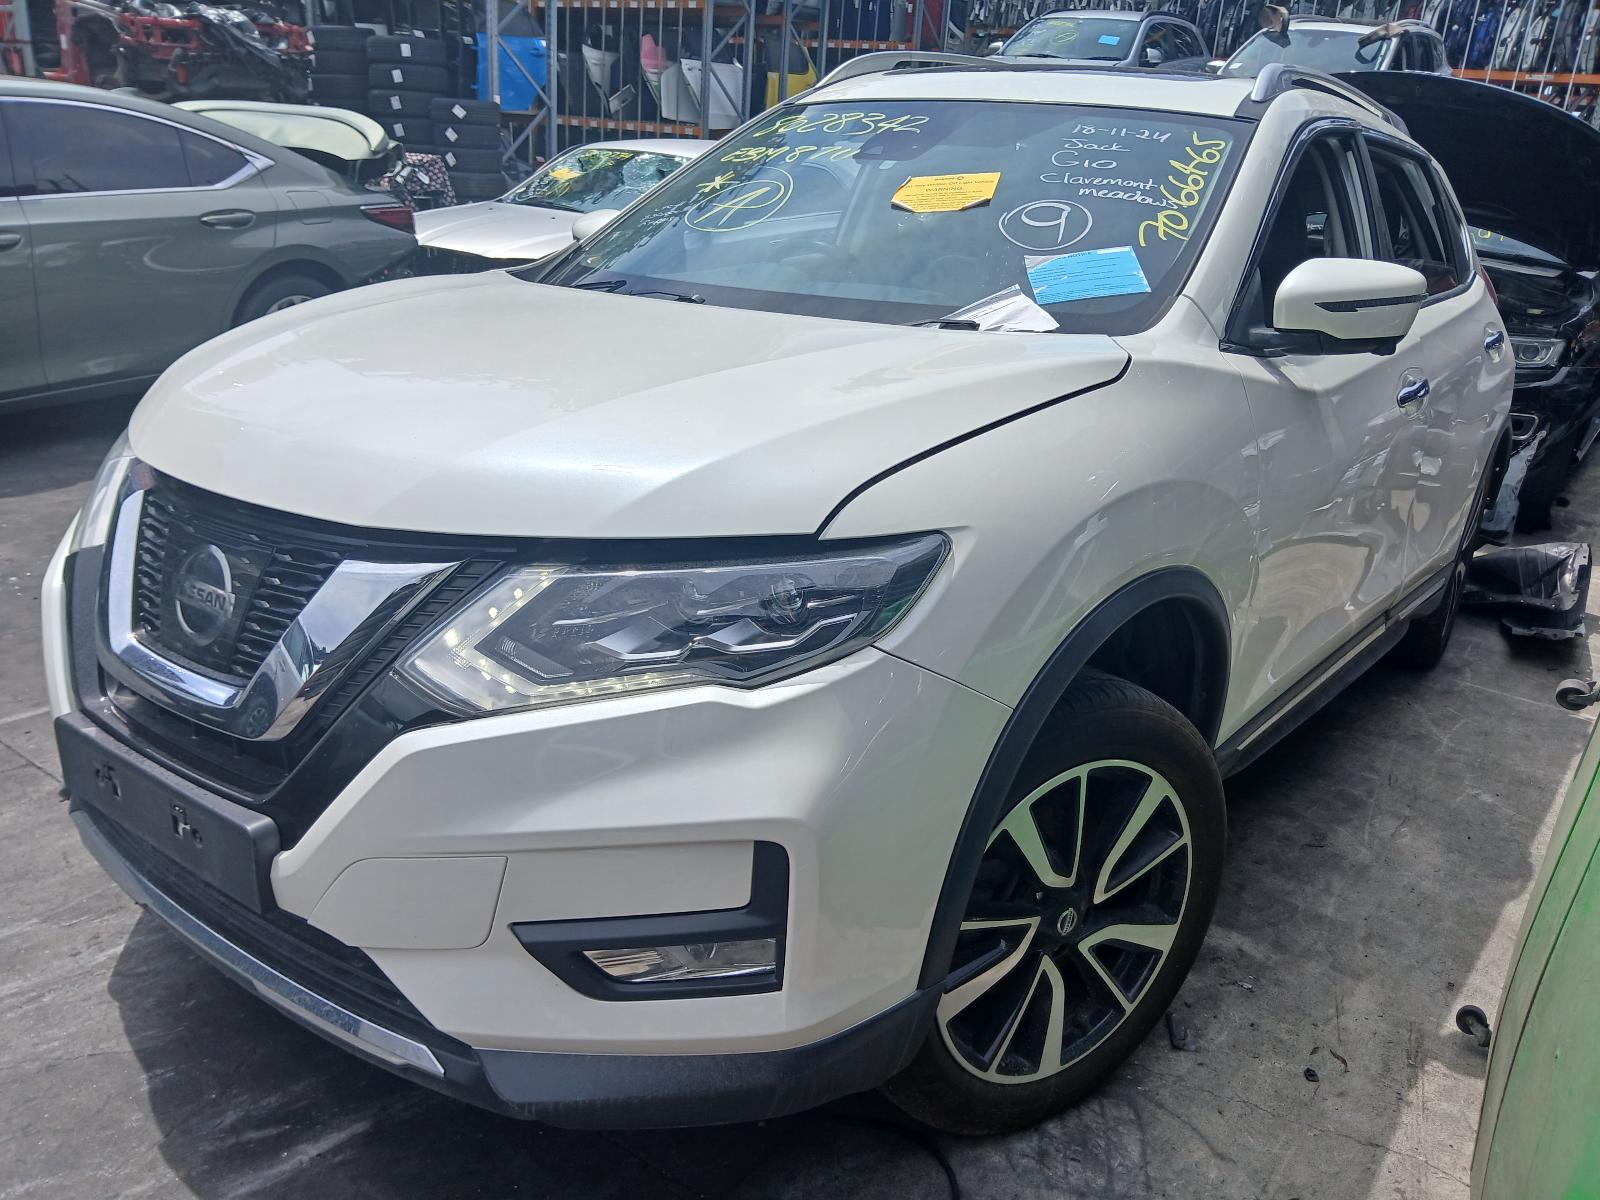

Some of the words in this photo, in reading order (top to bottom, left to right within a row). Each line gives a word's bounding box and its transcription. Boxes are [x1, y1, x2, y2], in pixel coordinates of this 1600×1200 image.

[1071, 123, 1172, 143] 18-11-24
[1061, 138, 1132, 152] Jack
[1039, 172, 1158, 190] Claremont
[1137, 130, 1227, 247] 7066465
